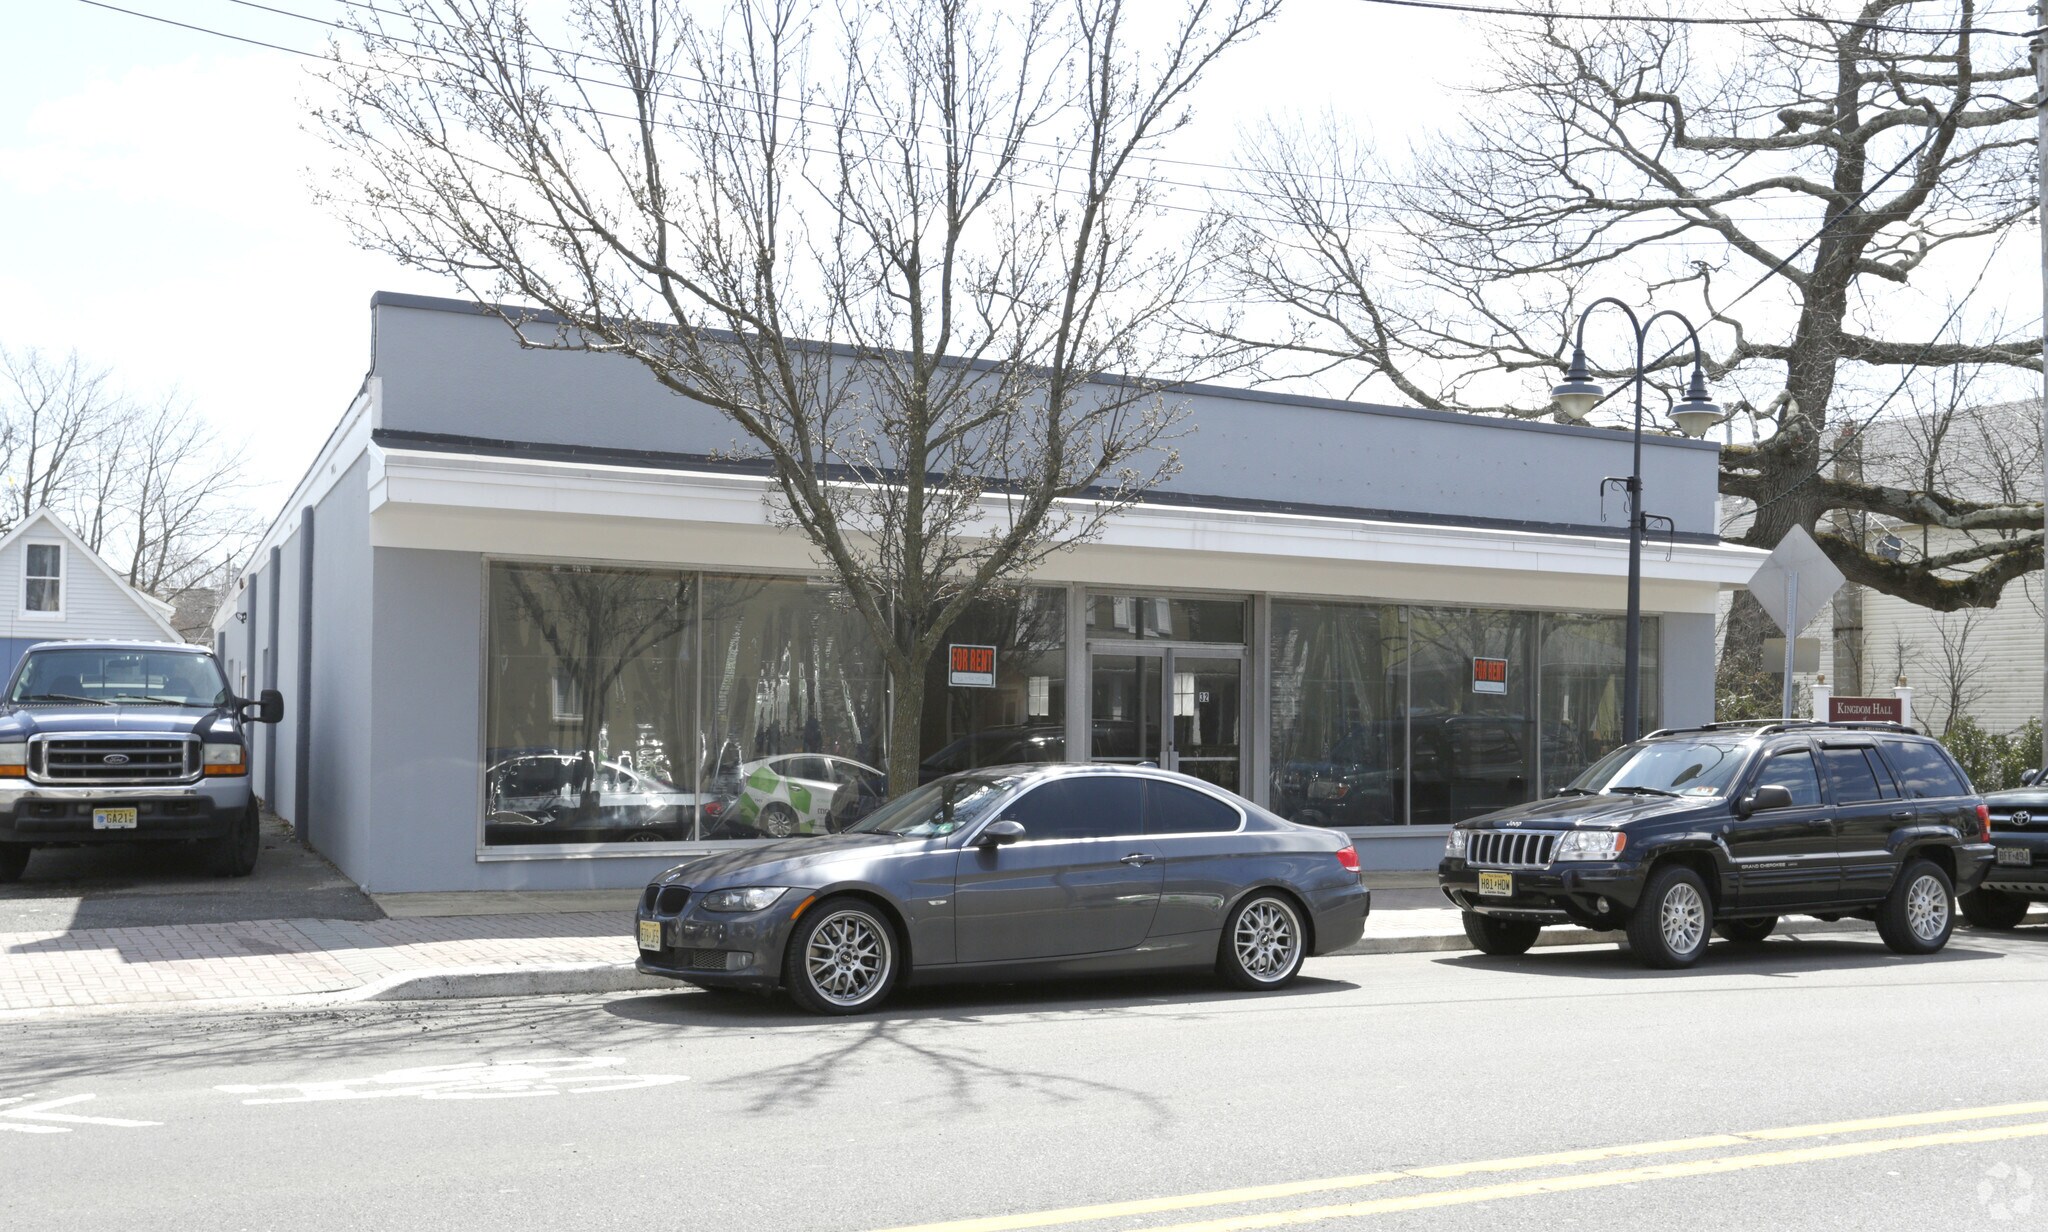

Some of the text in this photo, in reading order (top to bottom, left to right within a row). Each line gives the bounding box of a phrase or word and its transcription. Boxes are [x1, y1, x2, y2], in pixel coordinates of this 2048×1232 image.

[952, 647, 992, 672] FOR RENT
[1475, 660, 1504, 681] FOR RENT
[1200, 692, 1209, 702] 32
